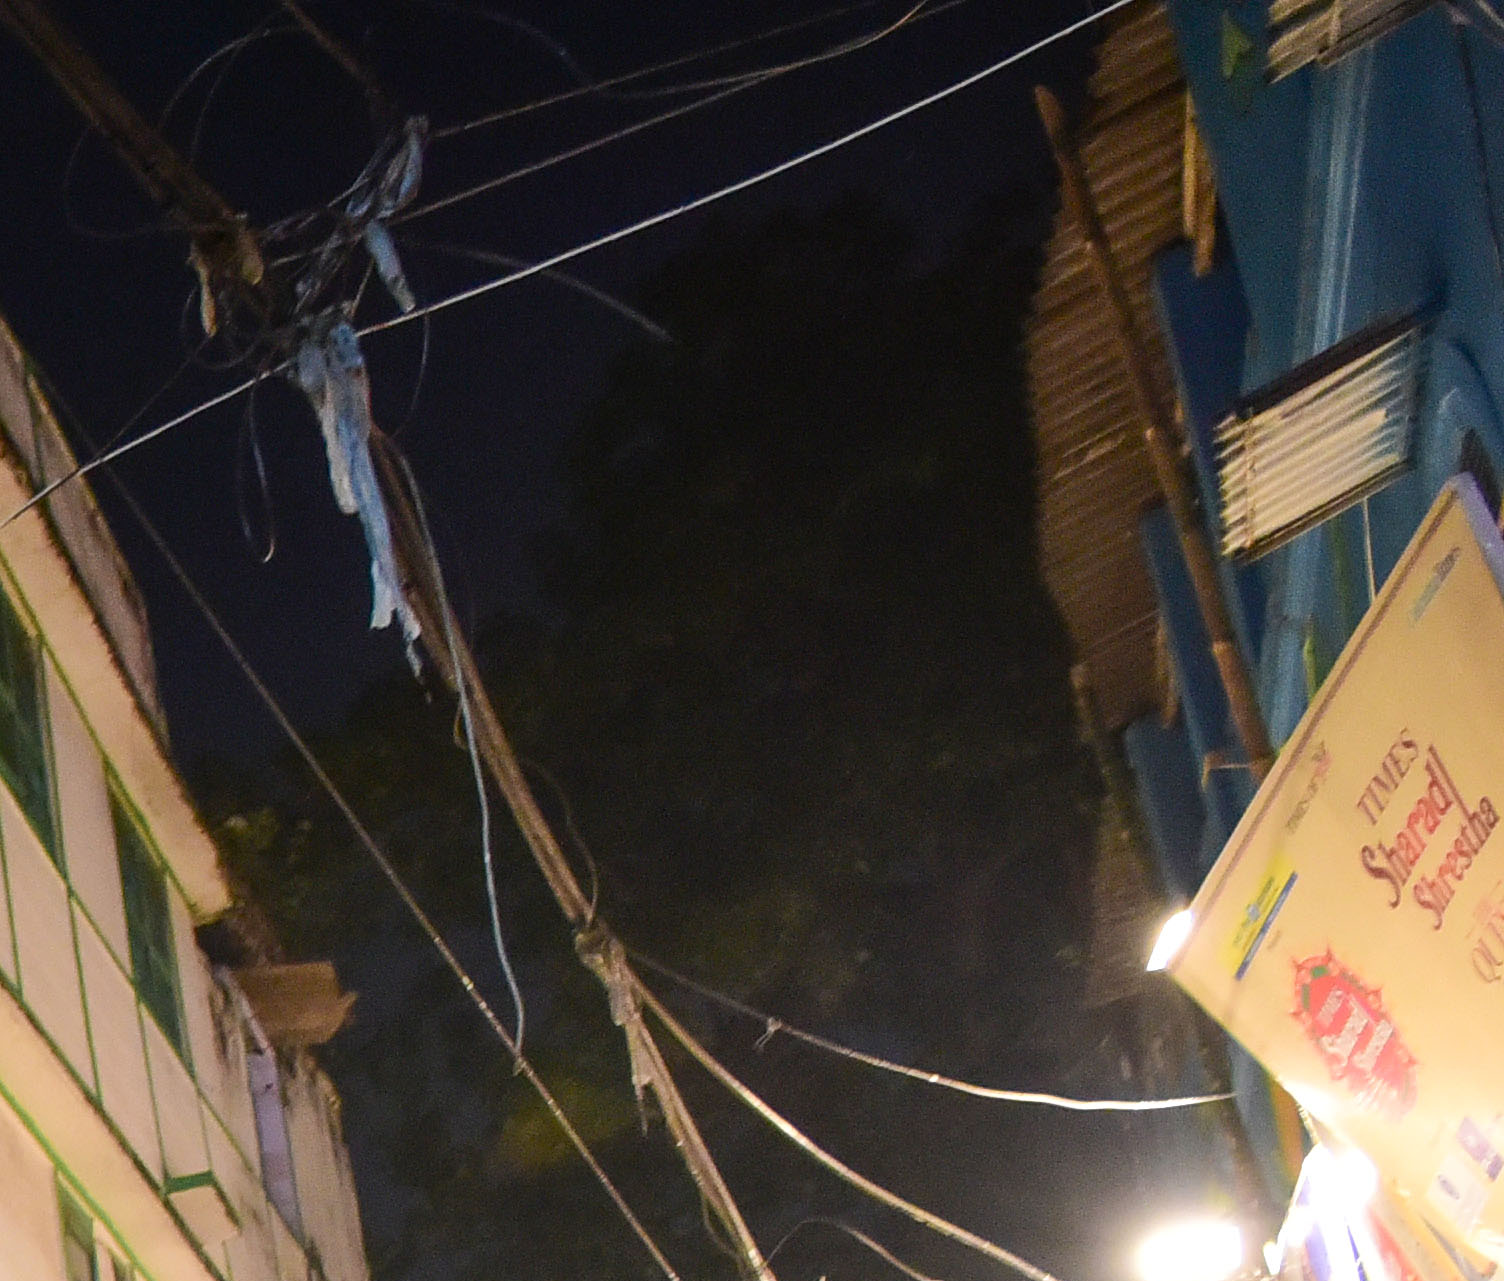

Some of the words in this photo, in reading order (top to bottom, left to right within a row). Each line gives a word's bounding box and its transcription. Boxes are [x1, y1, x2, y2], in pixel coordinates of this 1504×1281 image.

[1357, 727, 1419, 826] TIMES
[1362, 744, 1471, 909] Sharad
[1413, 796, 1500, 930] Shrestha
